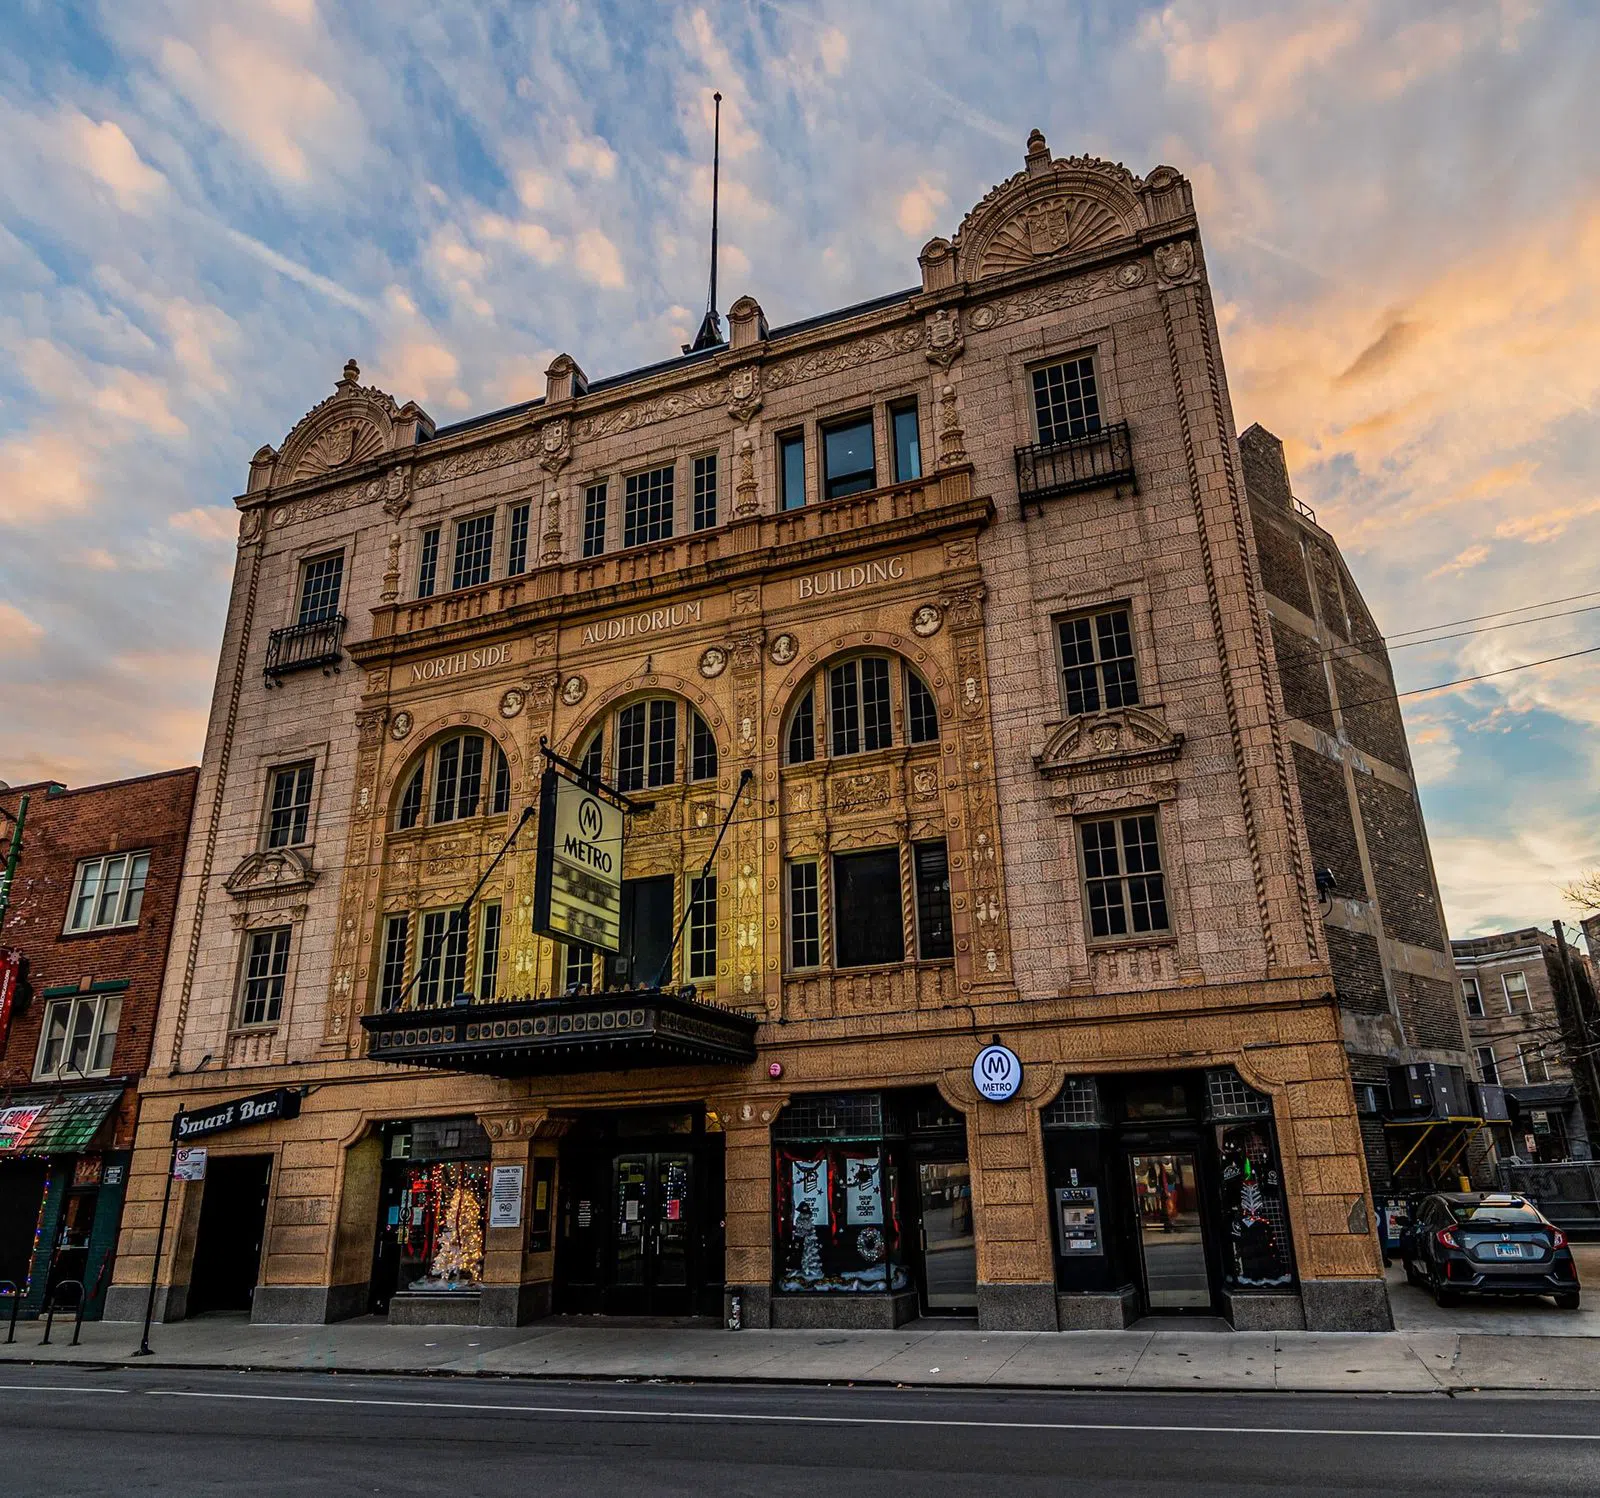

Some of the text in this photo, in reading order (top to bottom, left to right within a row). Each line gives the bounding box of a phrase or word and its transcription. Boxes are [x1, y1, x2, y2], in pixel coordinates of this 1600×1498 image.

[410, 557, 905, 685] NORTH SIDE AUDITORIUM BUILDING
[563, 833, 612, 873] METRO
[982, 1082, 1012, 1091] METRO
[178, 1100, 278, 1136] Smart Bar
